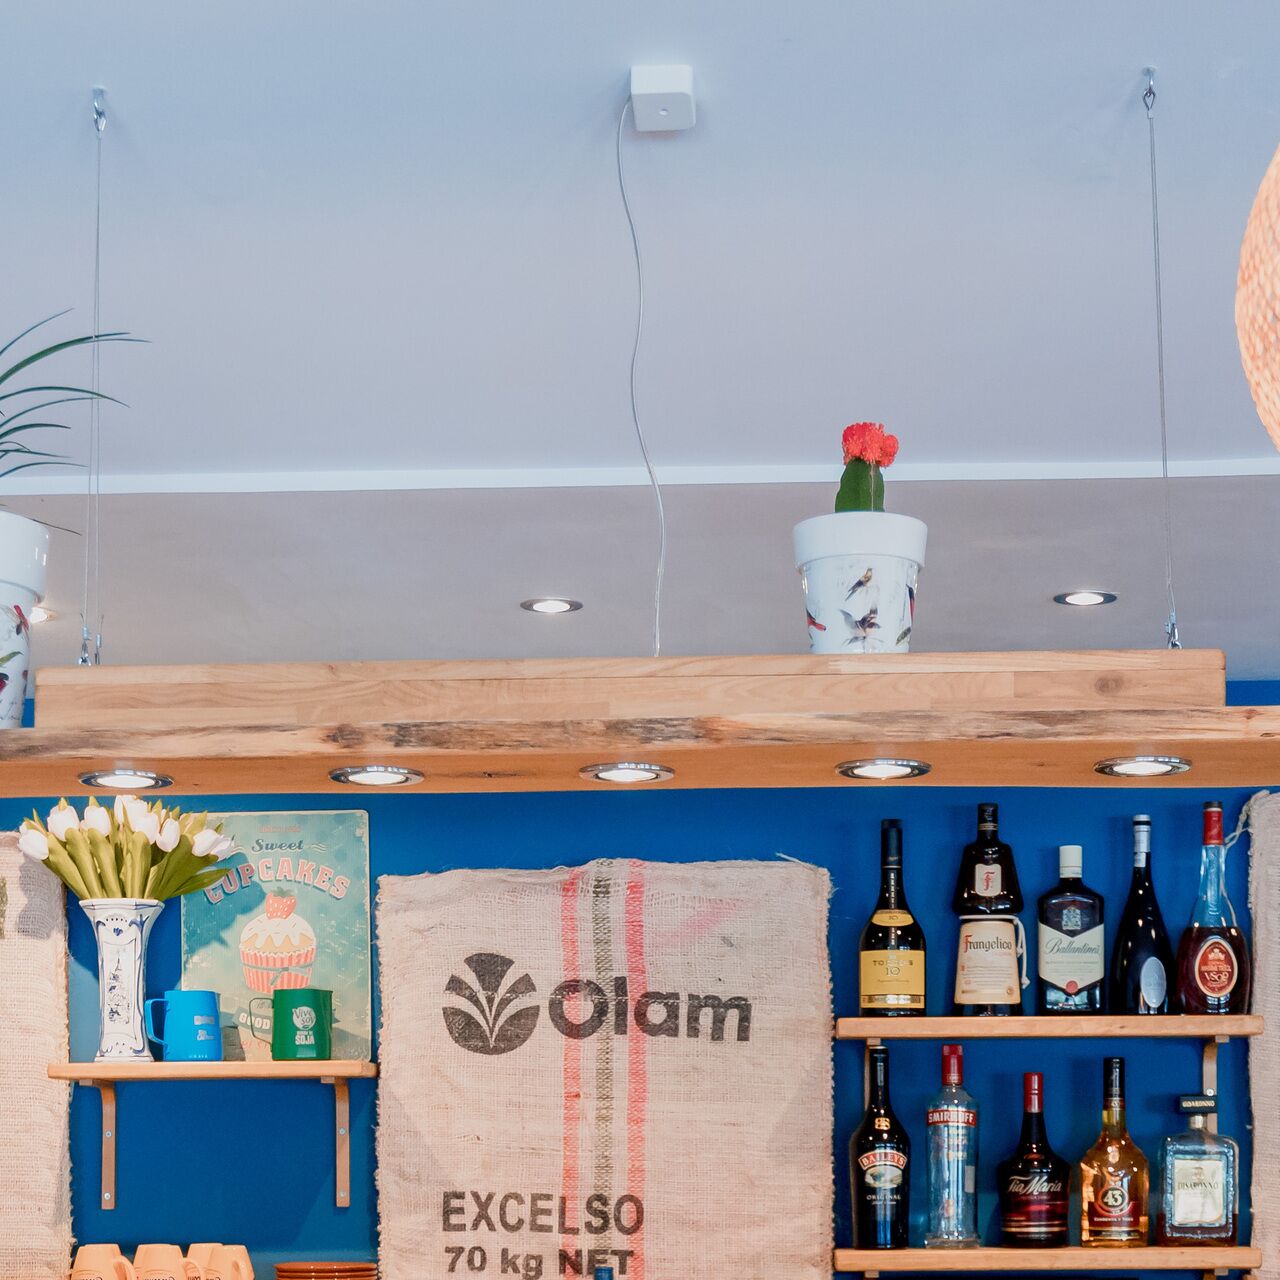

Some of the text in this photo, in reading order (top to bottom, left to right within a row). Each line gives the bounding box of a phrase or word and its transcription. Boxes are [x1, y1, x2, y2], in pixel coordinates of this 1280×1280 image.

[252, 838, 305, 852] Sweet
[203, 857, 352, 904] CUPCAKES
[963, 935, 1012, 952] Frangelico
[547, 975, 752, 1043] Olam
[928, 1111, 975, 1124] SMIROFF
[862, 1151, 904, 1167] BAILEYS
[442, 1190, 645, 1237] EXCELSO
[445, 1245, 634, 1280] 70 kg NET
